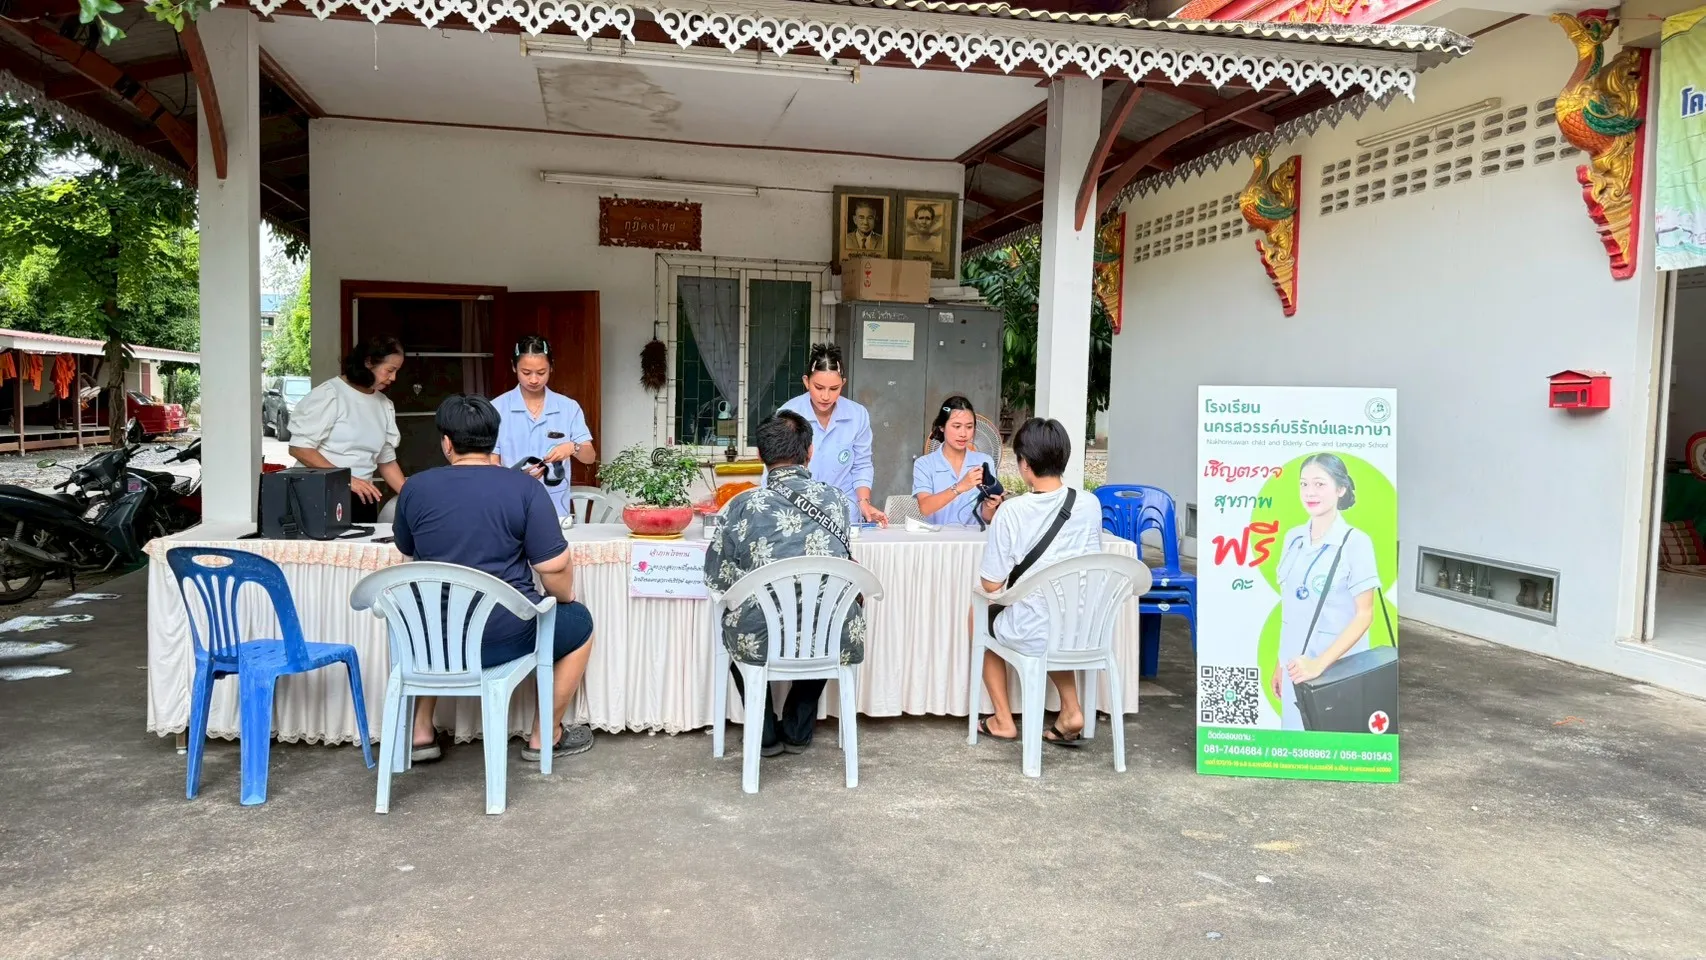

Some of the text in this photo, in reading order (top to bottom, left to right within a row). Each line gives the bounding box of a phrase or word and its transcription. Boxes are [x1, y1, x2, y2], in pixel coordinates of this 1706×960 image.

[1681, 87, 1706, 116] โค
[1204, 399, 1261, 414] โรงเรียน
[1204, 419, 1391, 436] นครสวรรค์บริรักษ์และภาษา
[1336, 441, 1366, 449] Language
[1368, 441, 1389, 449] School
[1203, 460, 1283, 483] เชิญตรวจ
[1214, 494, 1273, 514] สุขภาพ
[1211, 520, 1279, 568] ฟรี
[1231, 578, 1254, 591] คะ
